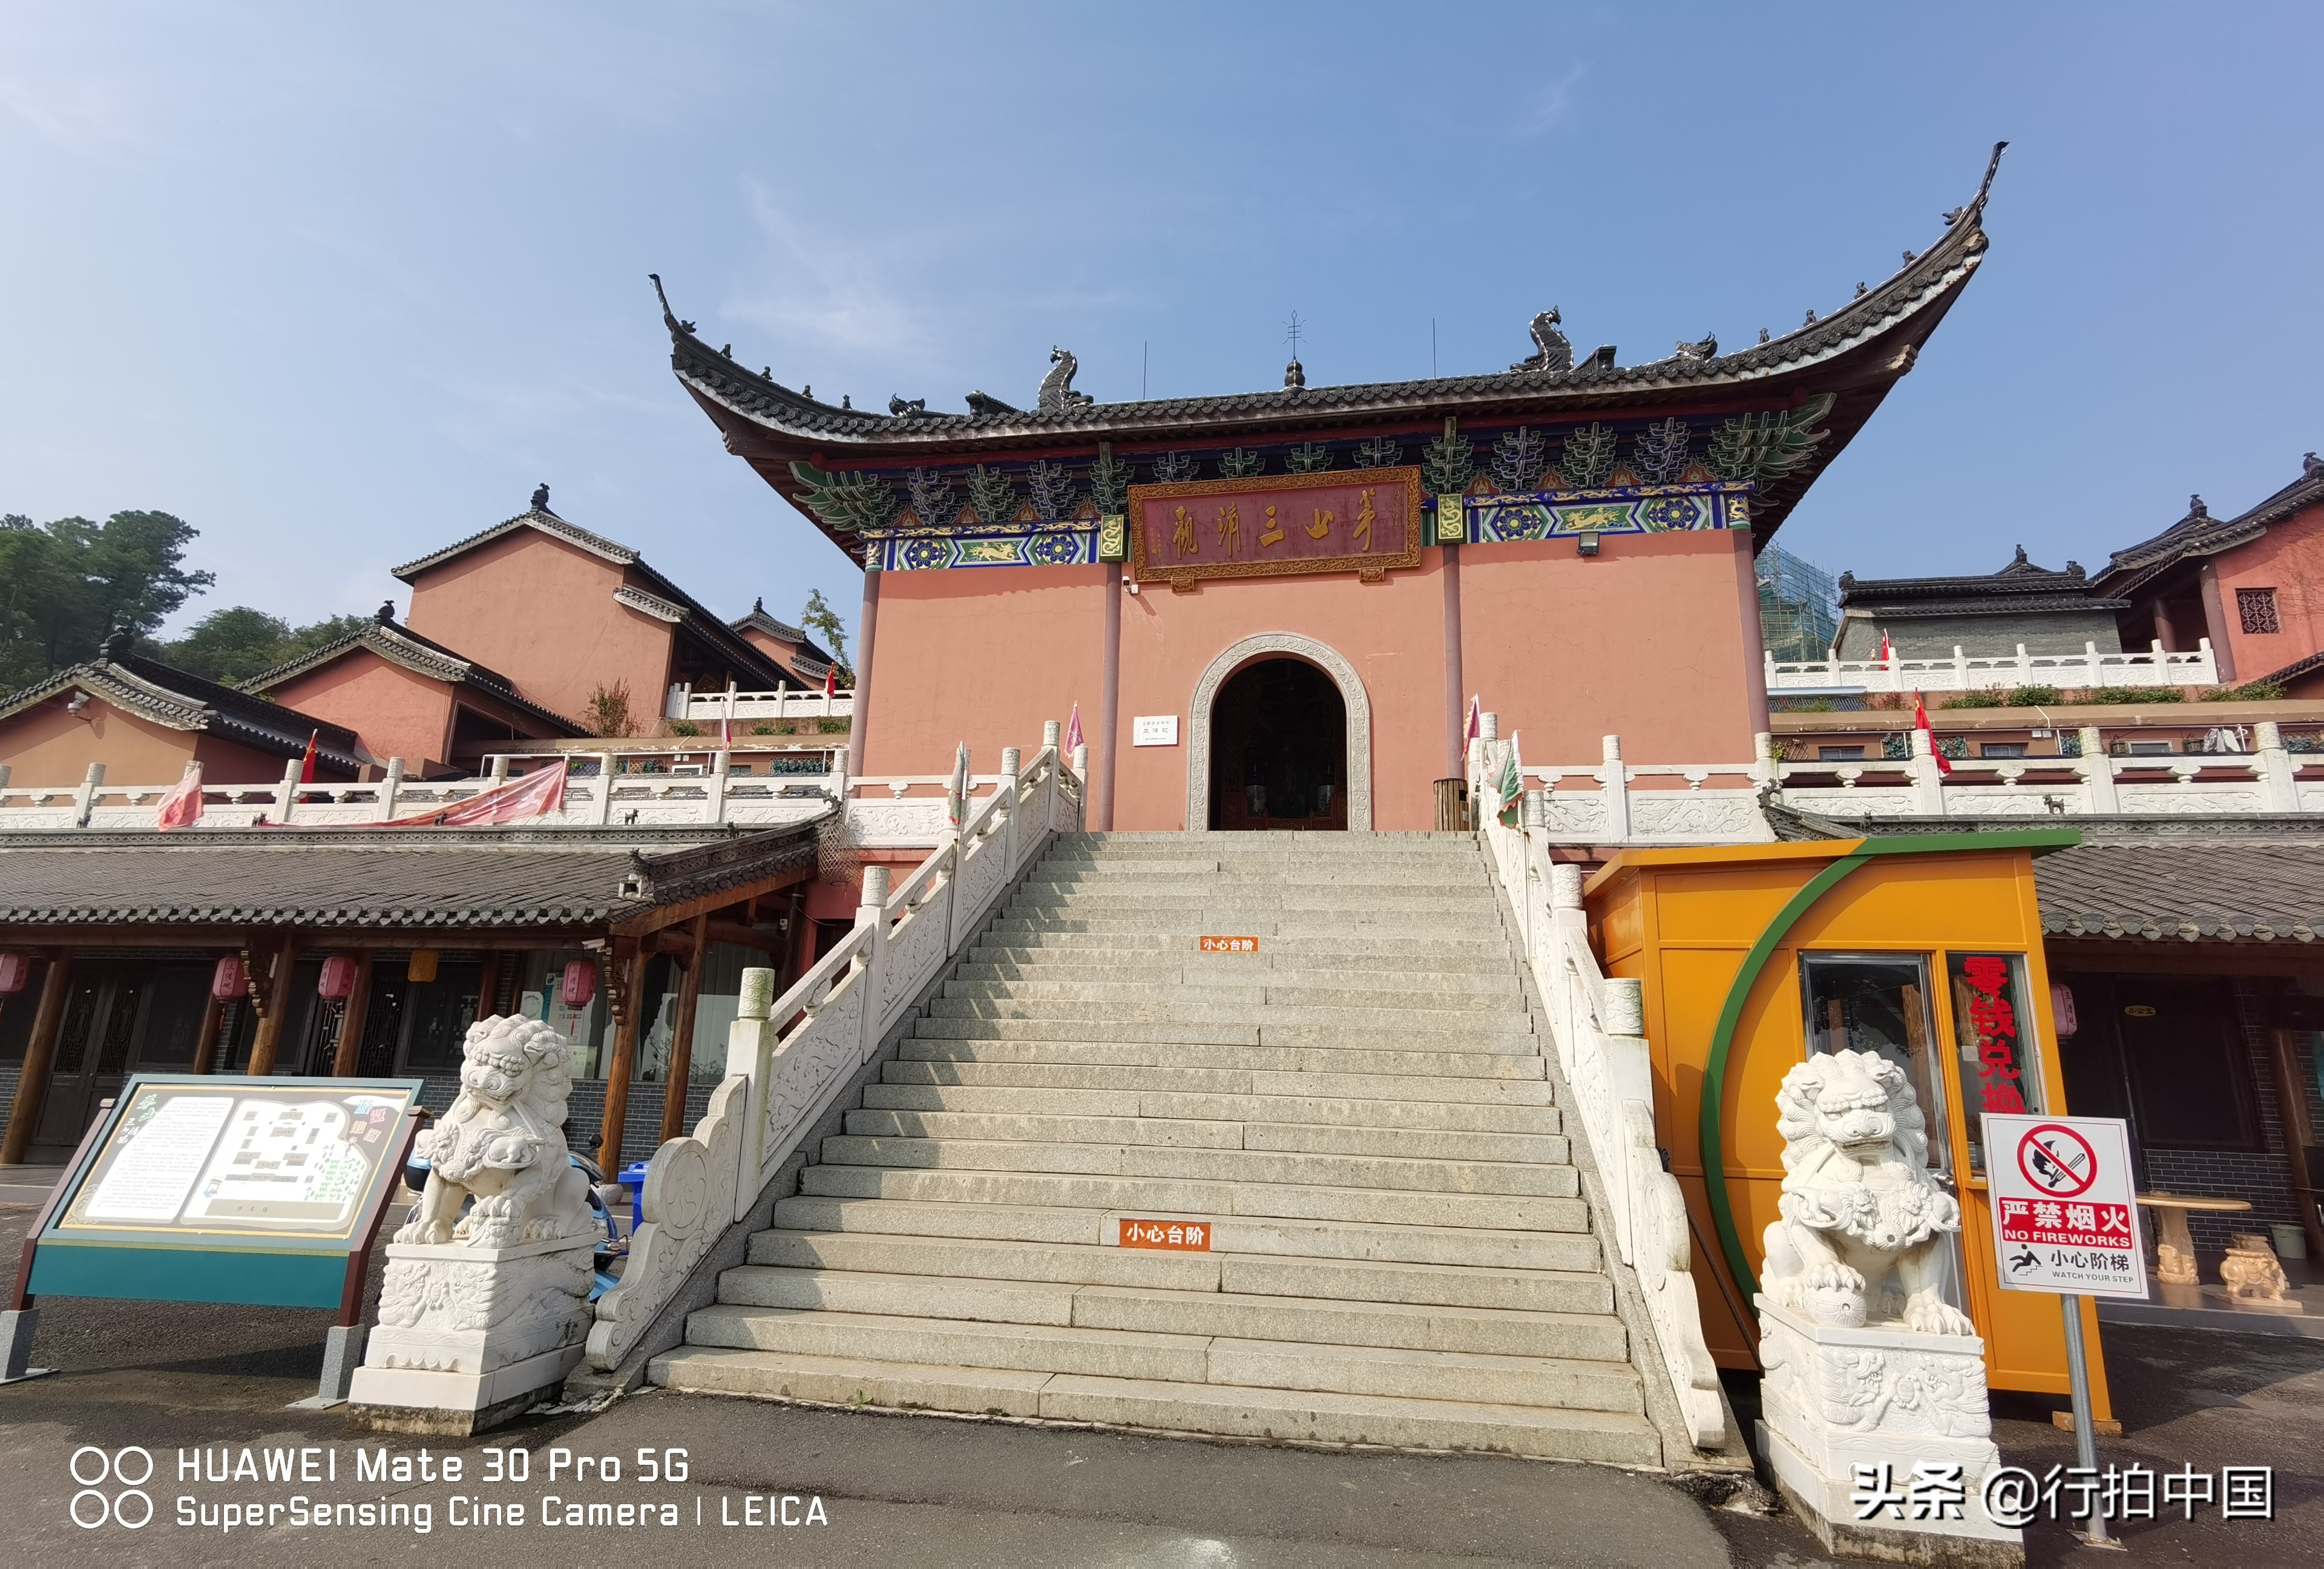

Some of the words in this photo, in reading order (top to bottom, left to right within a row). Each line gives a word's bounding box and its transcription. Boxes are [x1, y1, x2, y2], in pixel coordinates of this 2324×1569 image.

[1204, 939, 1253, 951] 小心台阶
[1964, 956, 2027, 1114] 零钱兑换
[2002, 1200, 2129, 1234] 严禁烟火
[1126, 1223, 1204, 1245] 小心台阶
[2004, 1229, 2029, 1240] NO
[2033, 1231, 2130, 1247] FIREWORKS
[2050, 1249, 2129, 1272] 小心阶梯
[2052, 1271, 2083, 1280] WATCH
